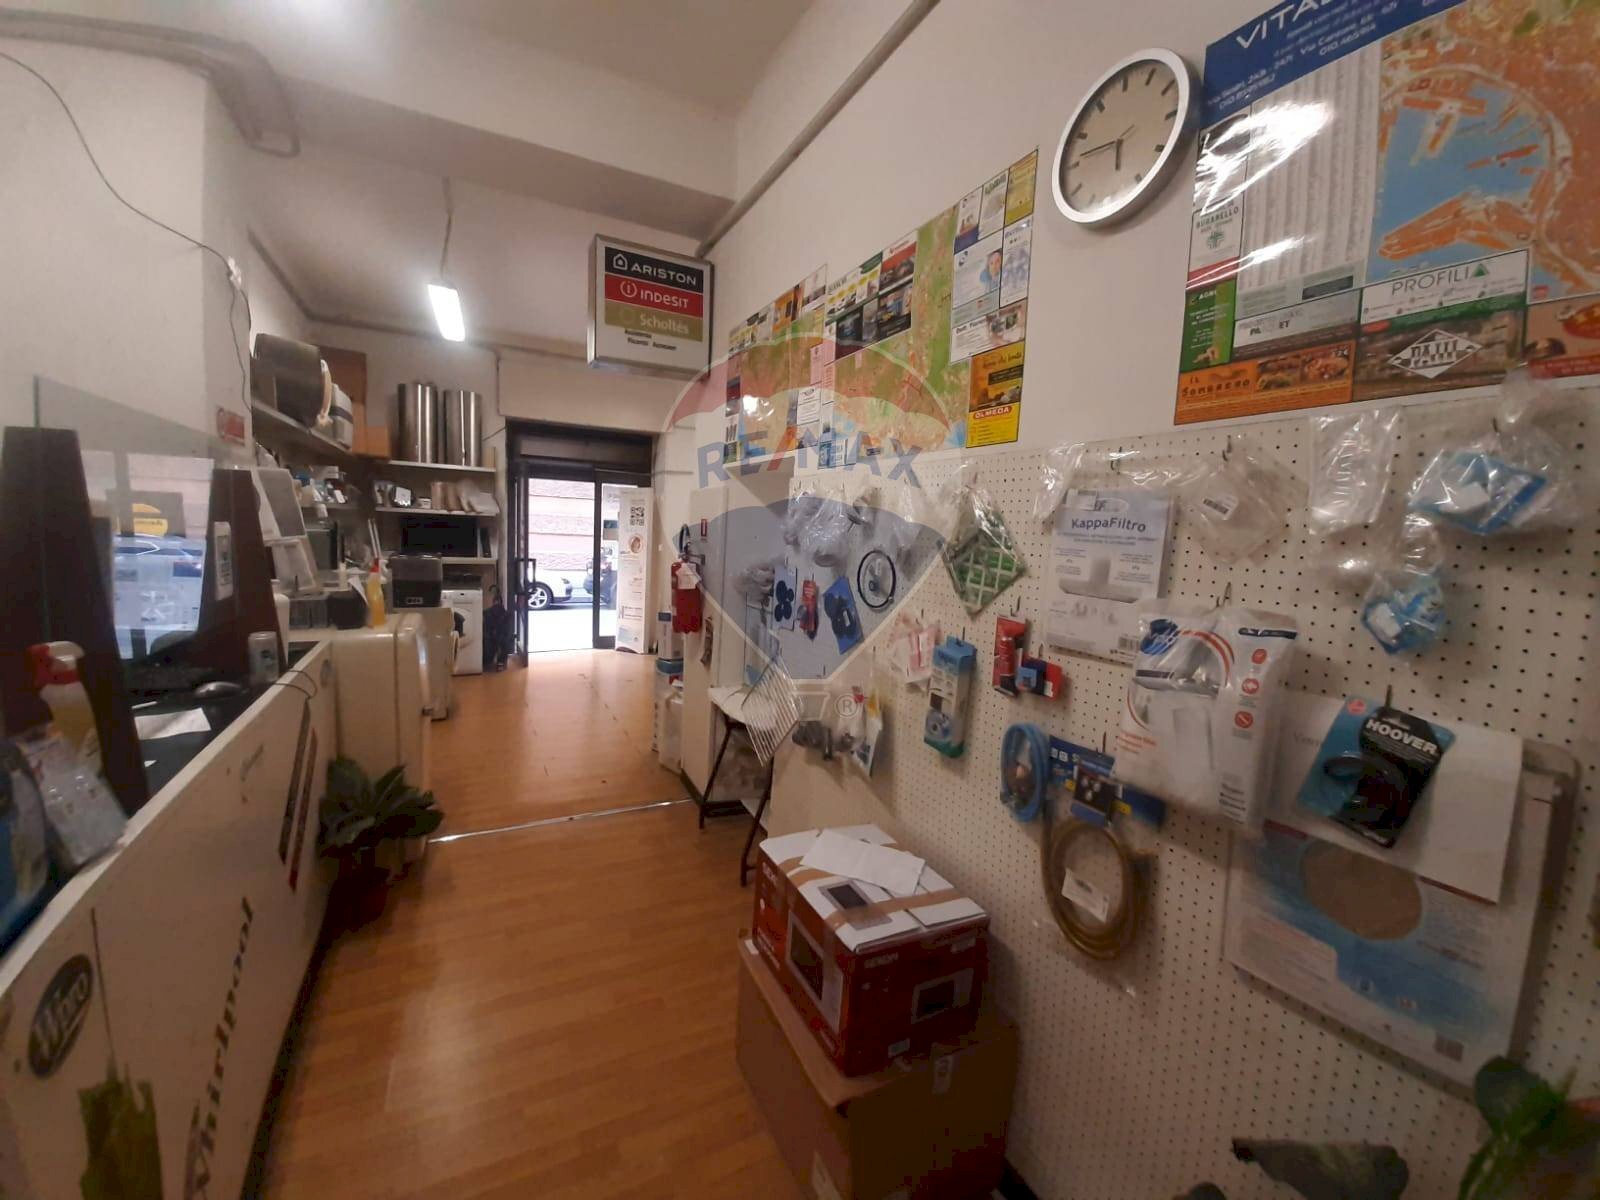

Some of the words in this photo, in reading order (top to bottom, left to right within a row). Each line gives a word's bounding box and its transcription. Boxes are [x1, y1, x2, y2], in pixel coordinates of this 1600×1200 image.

[1236, 0, 1333, 49] VITA
[631, 262, 697, 286] ARISTON
[1071, 517, 1147, 533] KappaFiltro
[1365, 718, 1439, 755] HOOVER
